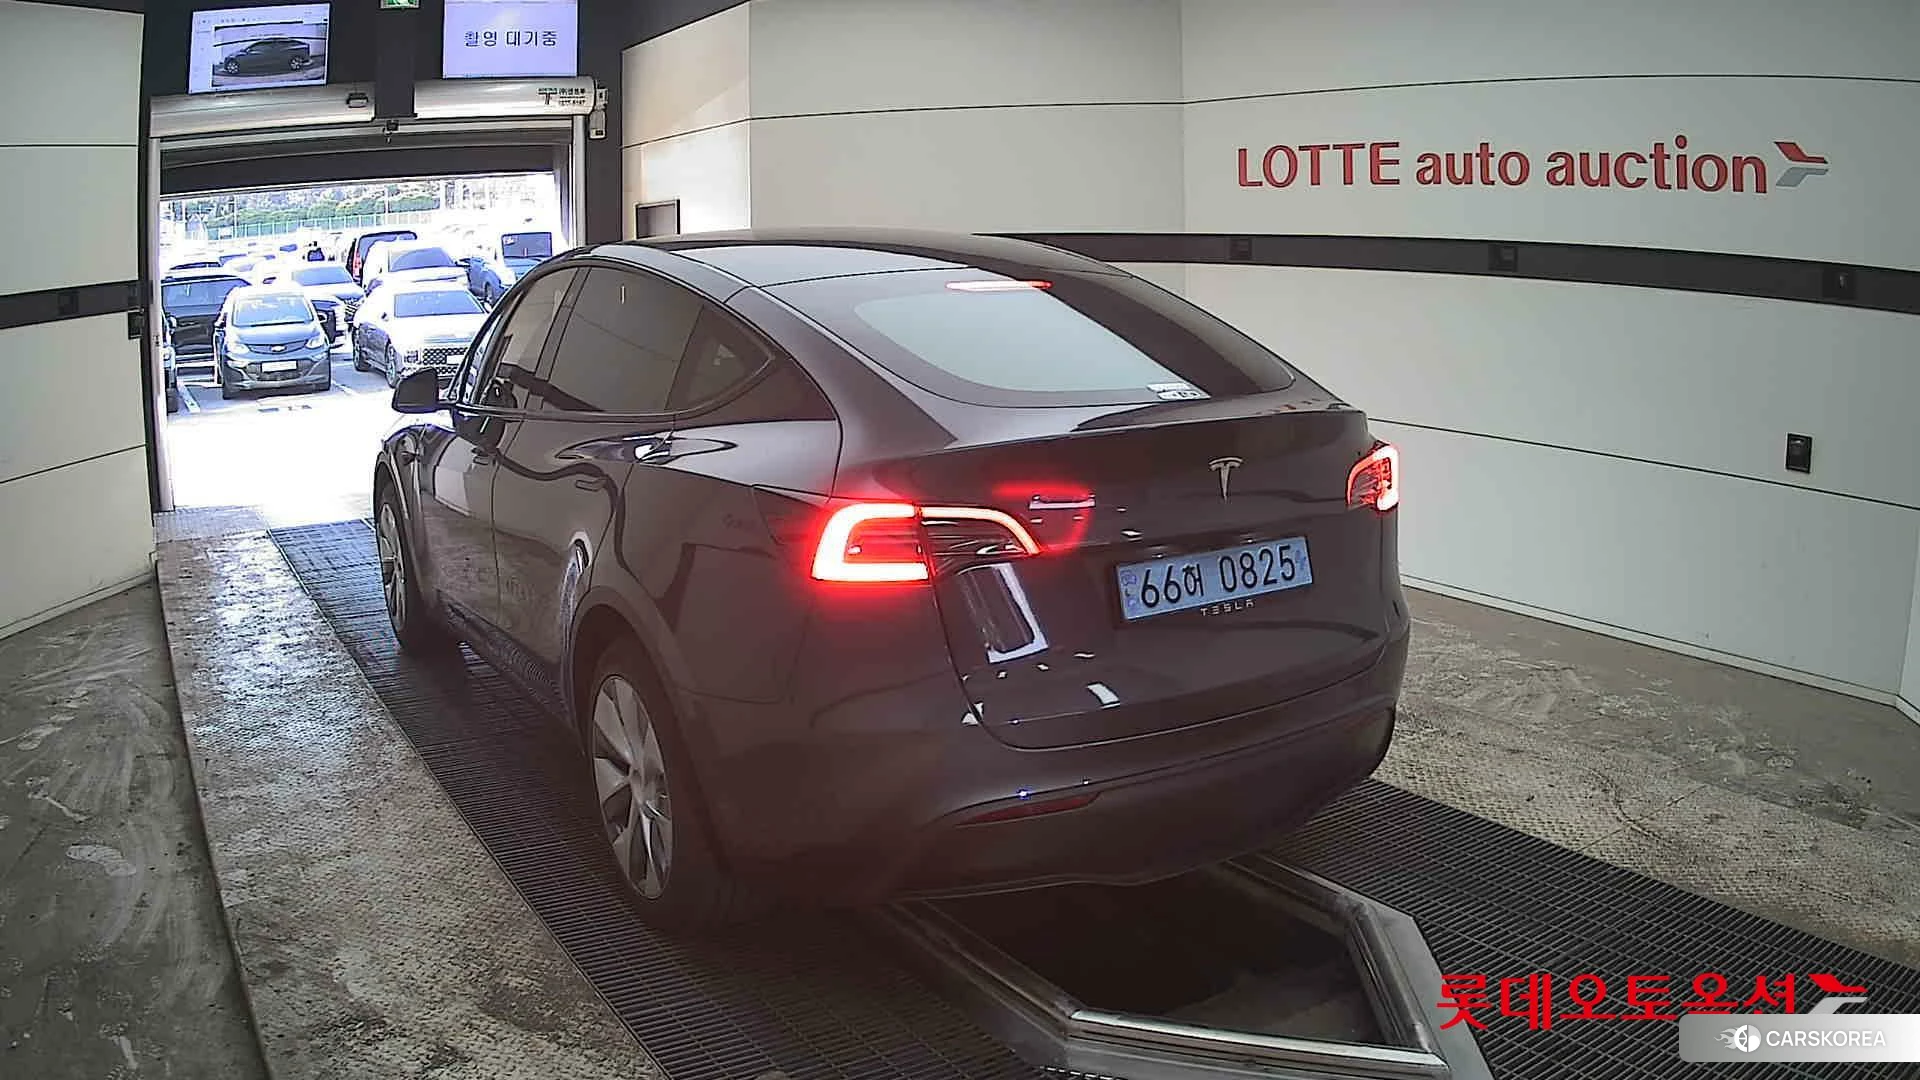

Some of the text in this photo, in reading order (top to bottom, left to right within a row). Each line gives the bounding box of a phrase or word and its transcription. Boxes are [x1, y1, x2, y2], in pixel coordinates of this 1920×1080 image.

[506, 30, 557, 47] 대기중
[1237, 135, 1768, 194] LOTTE auto auction
[1141, 563, 1204, 608] 66허
[1219, 545, 1296, 593] 0825
[1200, 599, 1255, 617] TESLA
